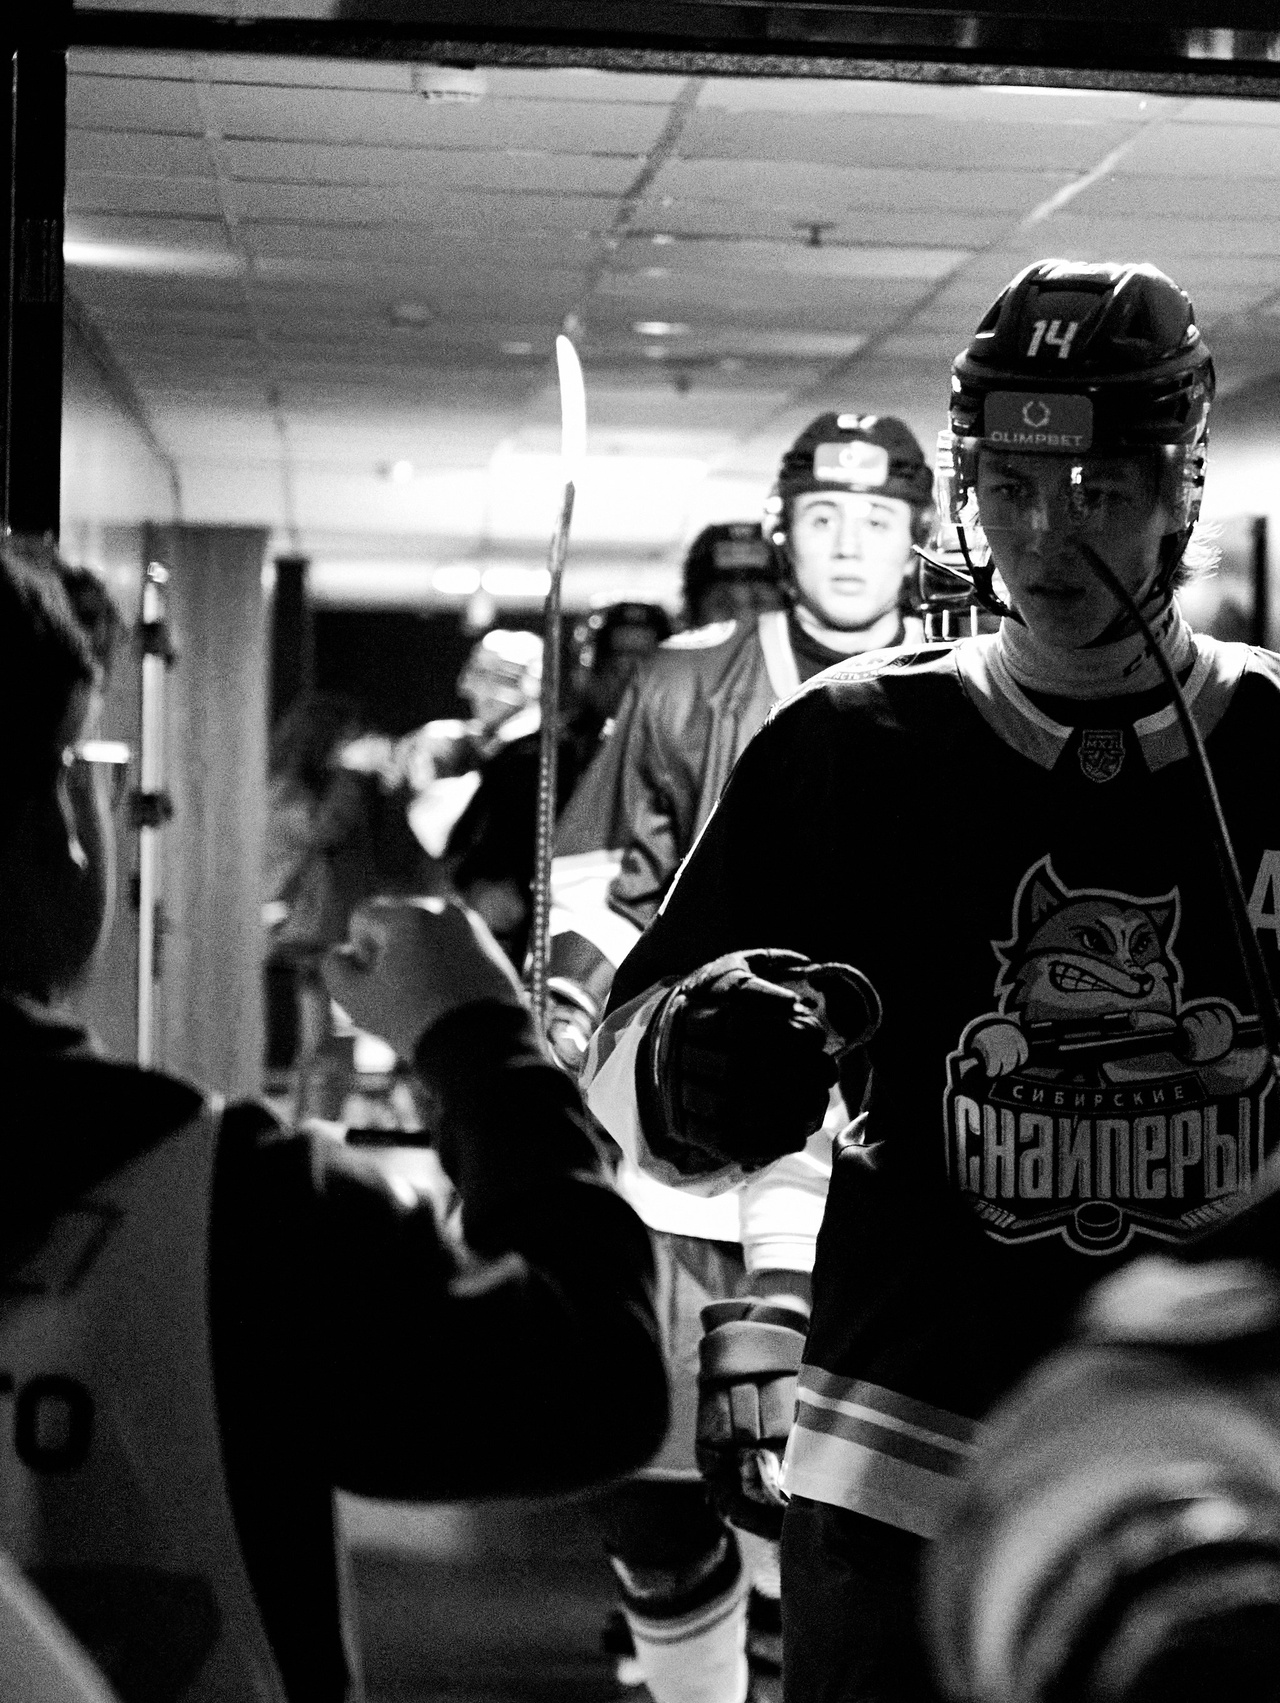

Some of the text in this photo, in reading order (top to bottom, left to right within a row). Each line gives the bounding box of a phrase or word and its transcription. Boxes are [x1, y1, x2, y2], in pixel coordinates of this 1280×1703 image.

[1027, 320, 1078, 359] 14
[990, 431, 1083, 447] OLIMPBET
[1012, 1085, 1185, 1107] СИБИРСКИЕ
